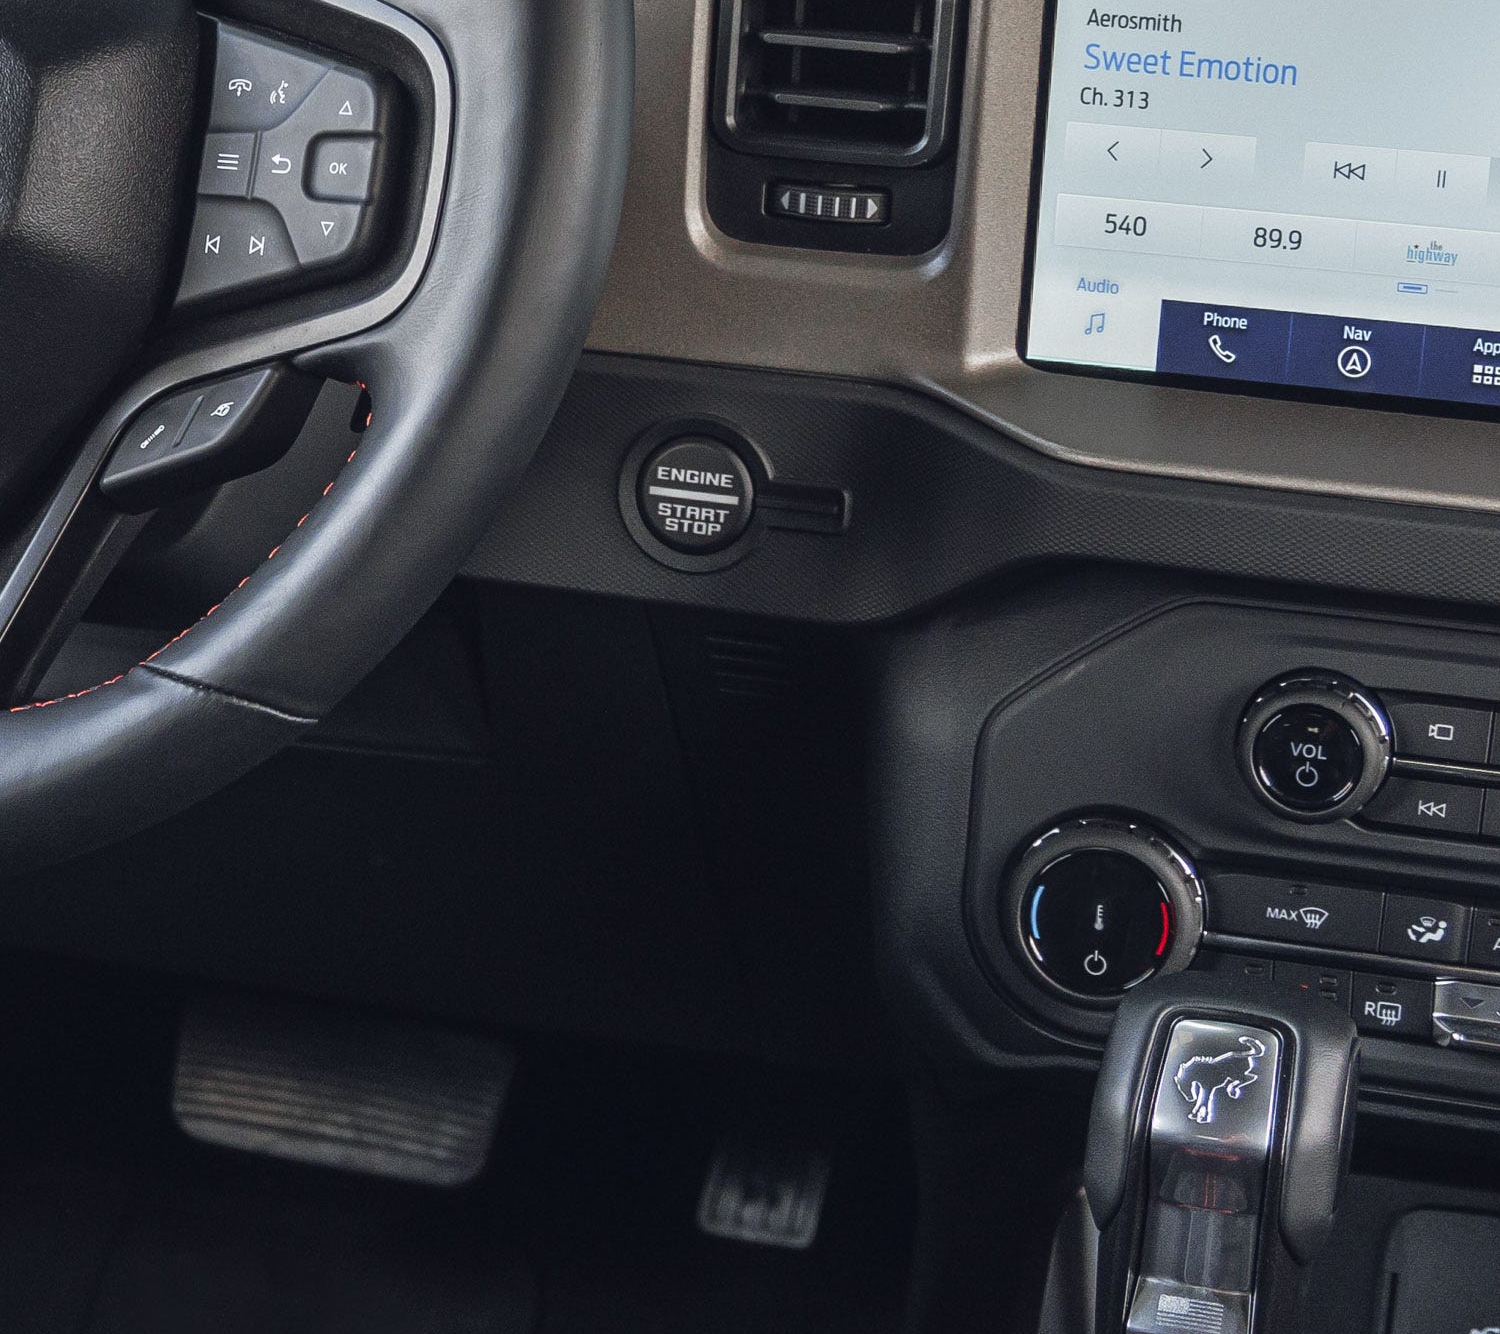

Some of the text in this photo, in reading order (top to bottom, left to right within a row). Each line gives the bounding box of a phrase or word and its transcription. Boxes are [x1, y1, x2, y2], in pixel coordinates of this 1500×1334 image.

[1087, 8, 1182, 34] Aerosmith
[1083, 43, 1298, 87] Sweet Emotion
[1080, 87, 1150, 111] Ch. 313
[329, 162, 347, 175] OK
[1104, 213, 1148, 239] 540
[1252, 226, 1303, 252] 89.9
[1430, 240, 1443, 251] the
[1406, 245, 1458, 266] highway
[1076, 276, 1120, 296] Audio
[1203, 311, 1248, 330] Phone
[1343, 325, 1372, 342] Nav
[657, 466, 734, 488] ENGINE
[657, 502, 730, 523] START
[665, 518, 722, 536] STOP
[1290, 741, 1328, 761] VOL
[1266, 906, 1299, 923] MAX
[1364, 1001, 1376, 1016] R
